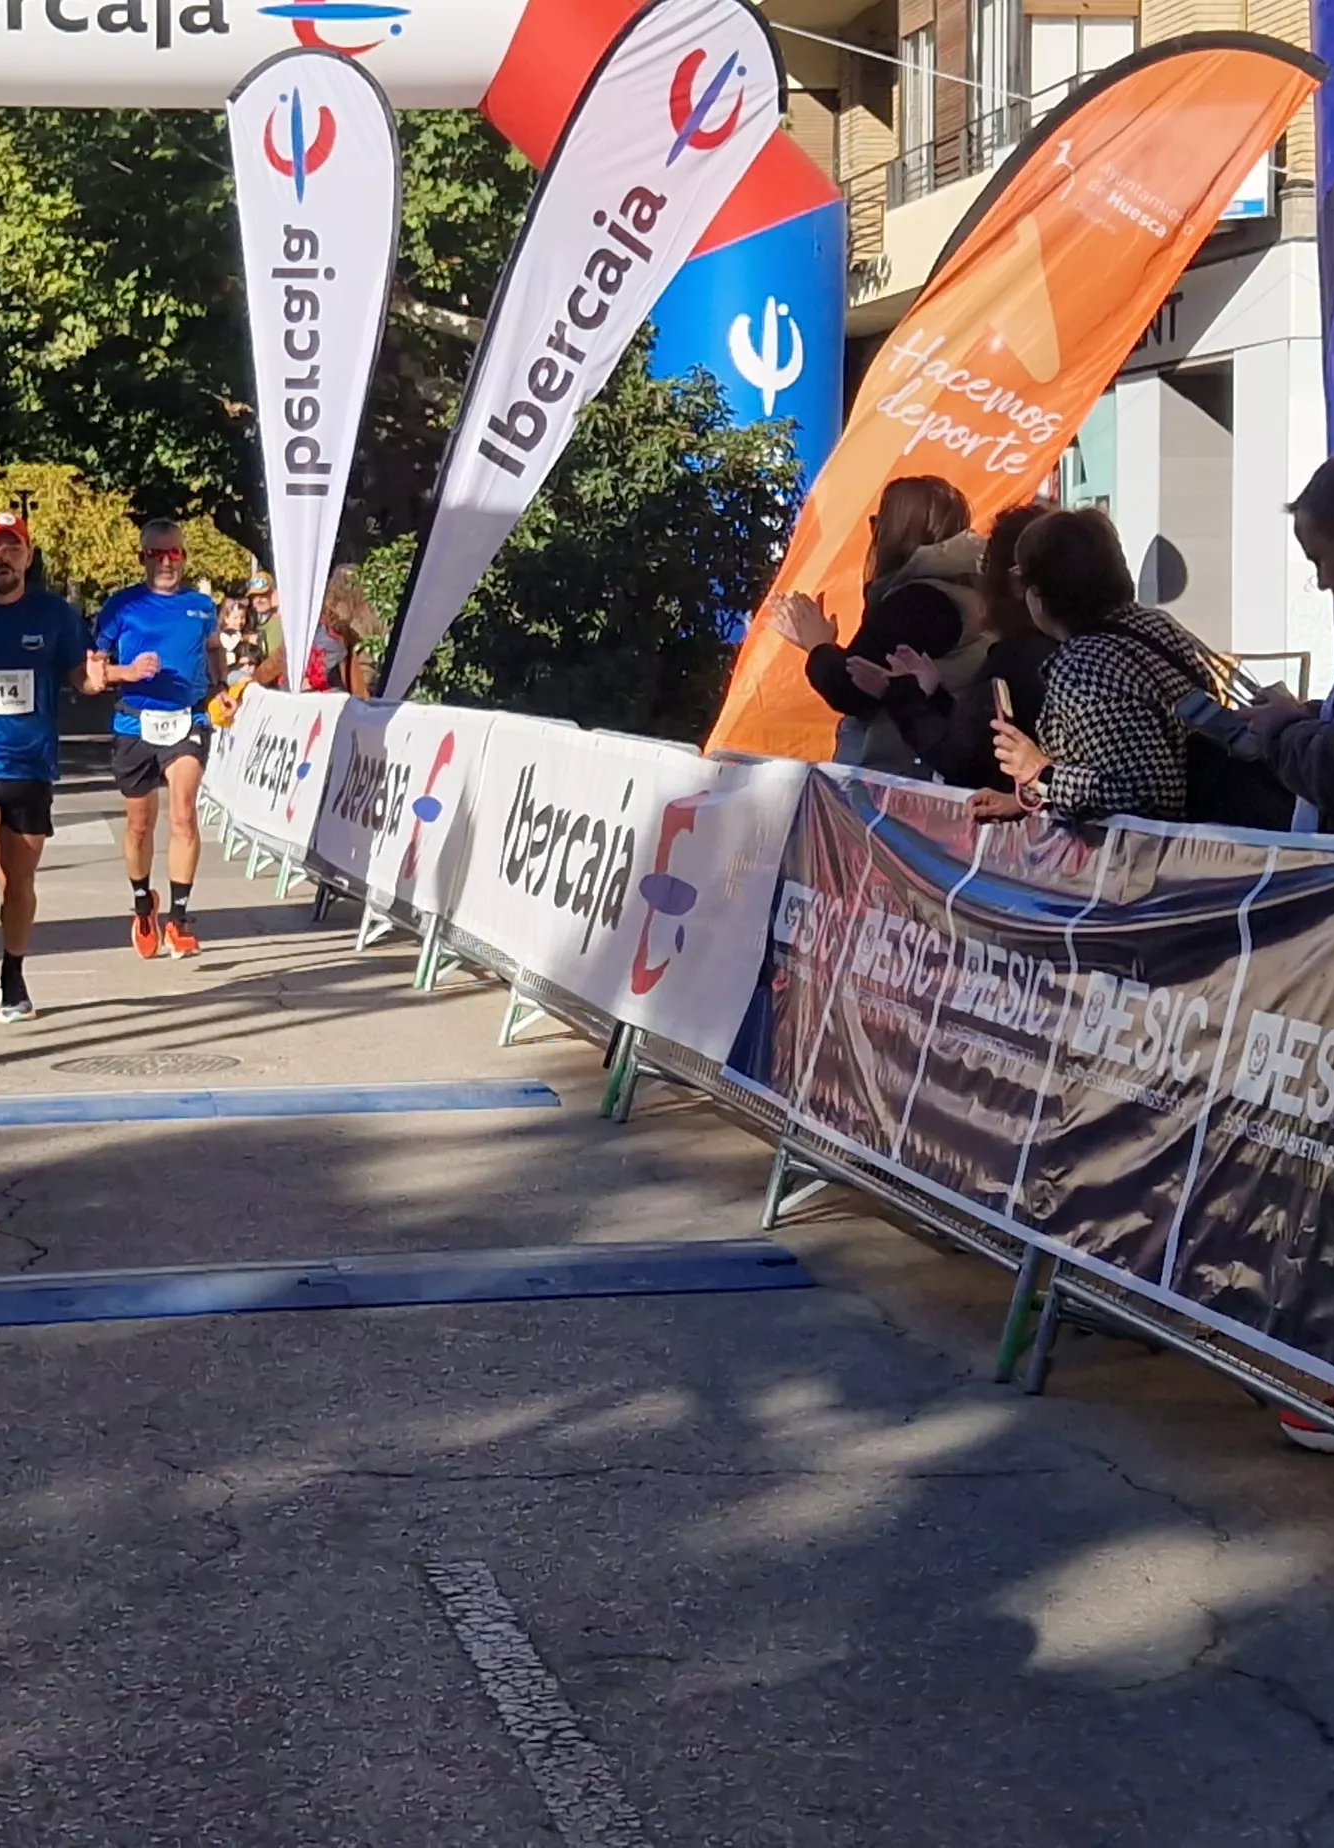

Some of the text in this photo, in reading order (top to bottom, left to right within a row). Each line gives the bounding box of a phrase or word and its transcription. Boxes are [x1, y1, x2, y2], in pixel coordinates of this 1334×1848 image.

[1106, 192, 1168, 239] Huesca
[478, 185, 668, 479] Ibercaja
[877, 377, 1029, 474] deporte
[888, 328, 1064, 444] Hacemos
[153, 719, 178, 732] 101
[499, 762, 635, 955] Ibercaja
[797, 889, 843, 962] SIC
[870, 912, 941, 998] ESIC
[973, 943, 1056, 1036] ESIC
[1101, 977, 1209, 1085] ESIC
